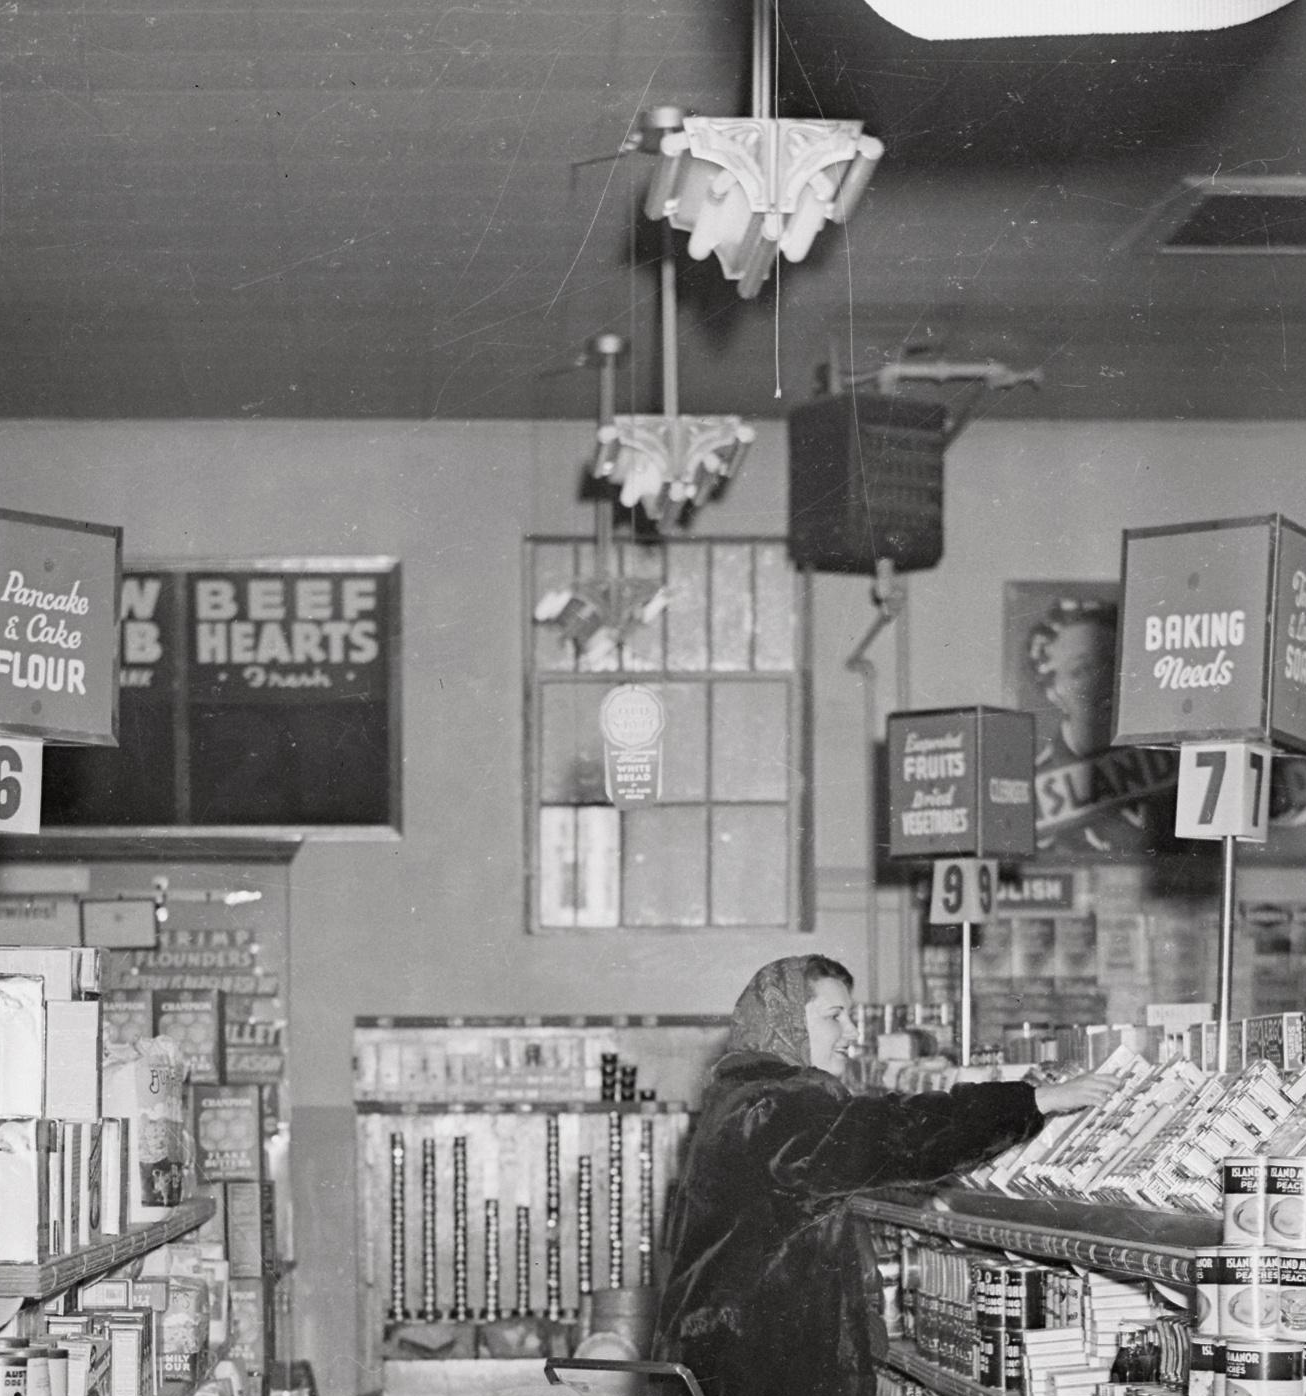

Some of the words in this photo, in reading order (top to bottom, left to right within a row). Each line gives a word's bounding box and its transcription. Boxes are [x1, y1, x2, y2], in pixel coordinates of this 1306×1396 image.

[1, 571, 89, 616] Pancake
[196, 578, 377, 621] BEEF
[4, 617, 19, 639] &
[26, 613, 82, 650] Cake
[197, 621, 380, 665] HEARTS
[1145, 610, 1246, 651] BAKING
[1153, 651, 1235, 690] Needs
[903, 752, 965, 782] FRUITS
[1195, 751, 1227, 826] 7
[942, 864, 964, 915] 9
[997, 879, 1062, 900] LISH
[135, 952, 251, 968] FLOUNDERS
[165, 1354, 191, 1363] MILY
[165, 1363, 191, 1372] OUR
